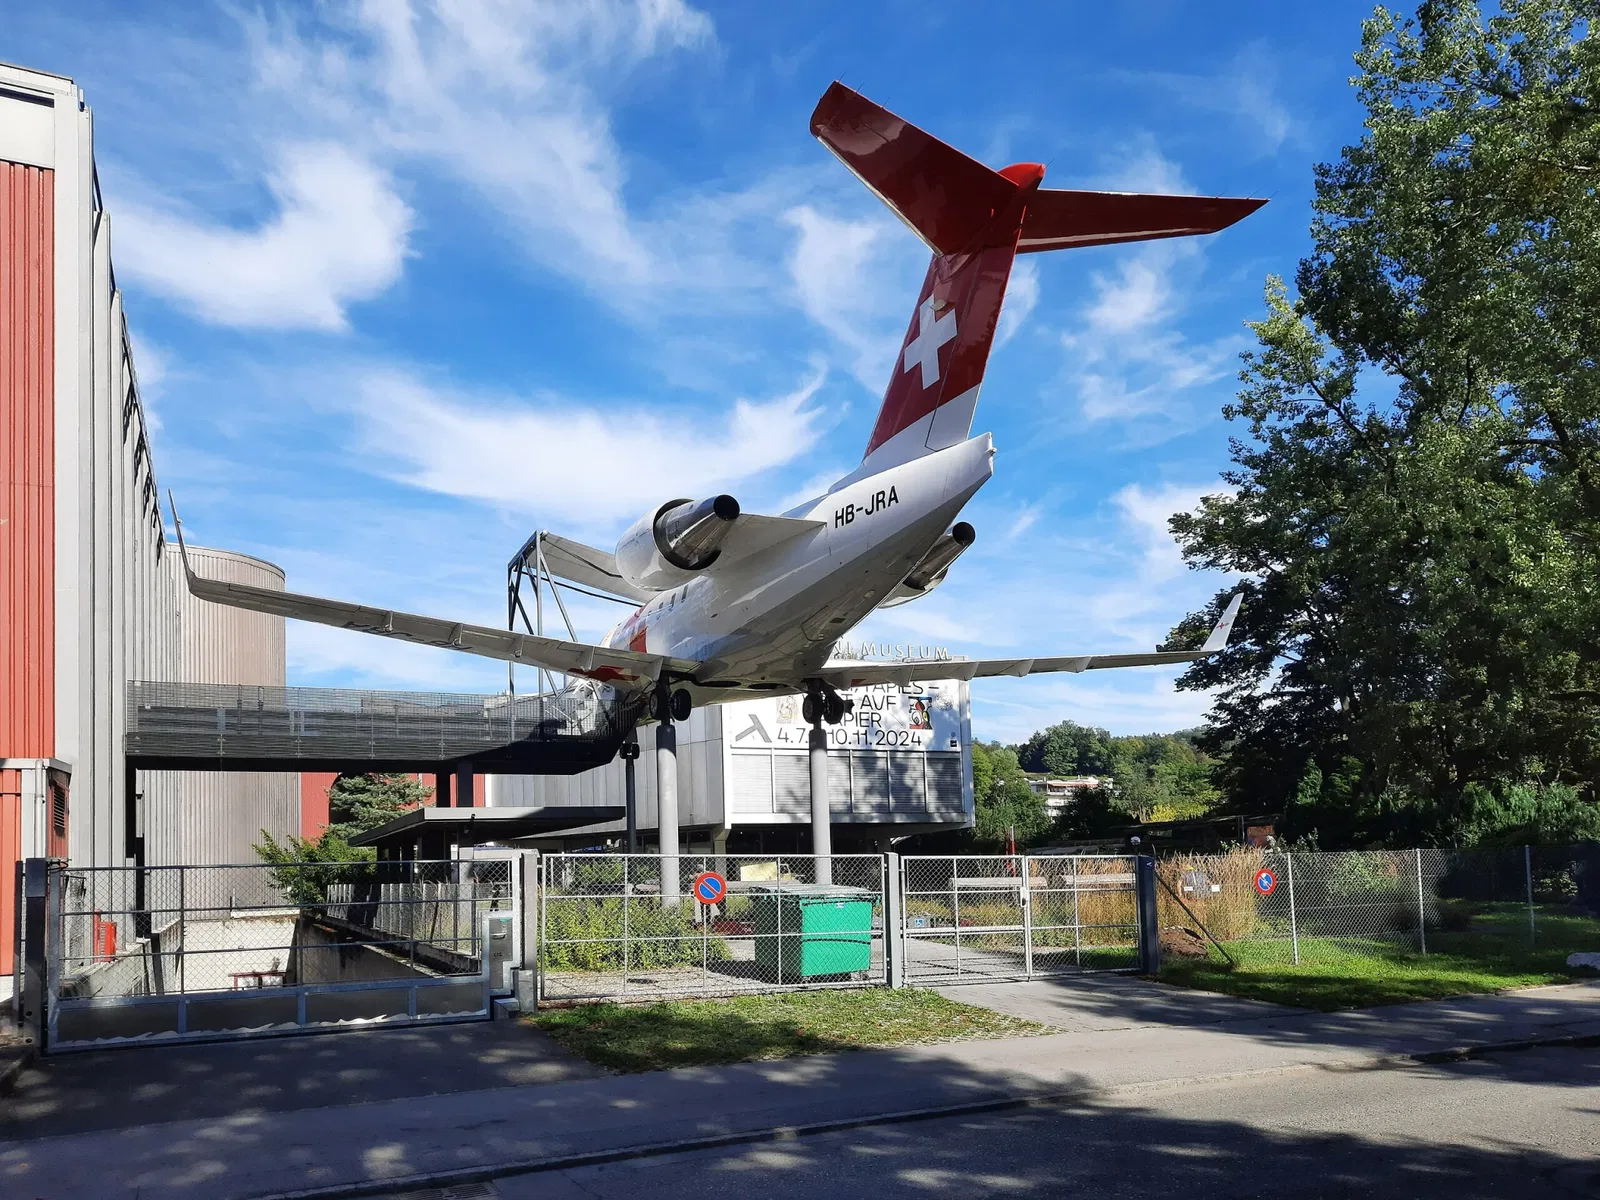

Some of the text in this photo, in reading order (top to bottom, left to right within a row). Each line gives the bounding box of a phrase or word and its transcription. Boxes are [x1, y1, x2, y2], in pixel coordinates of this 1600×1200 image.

[834, 485, 900, 529] HB-JRA
[861, 641, 949, 660] MUSEUM
[859, 694, 897, 710] AUF
[838, 711, 882, 728] PIER
